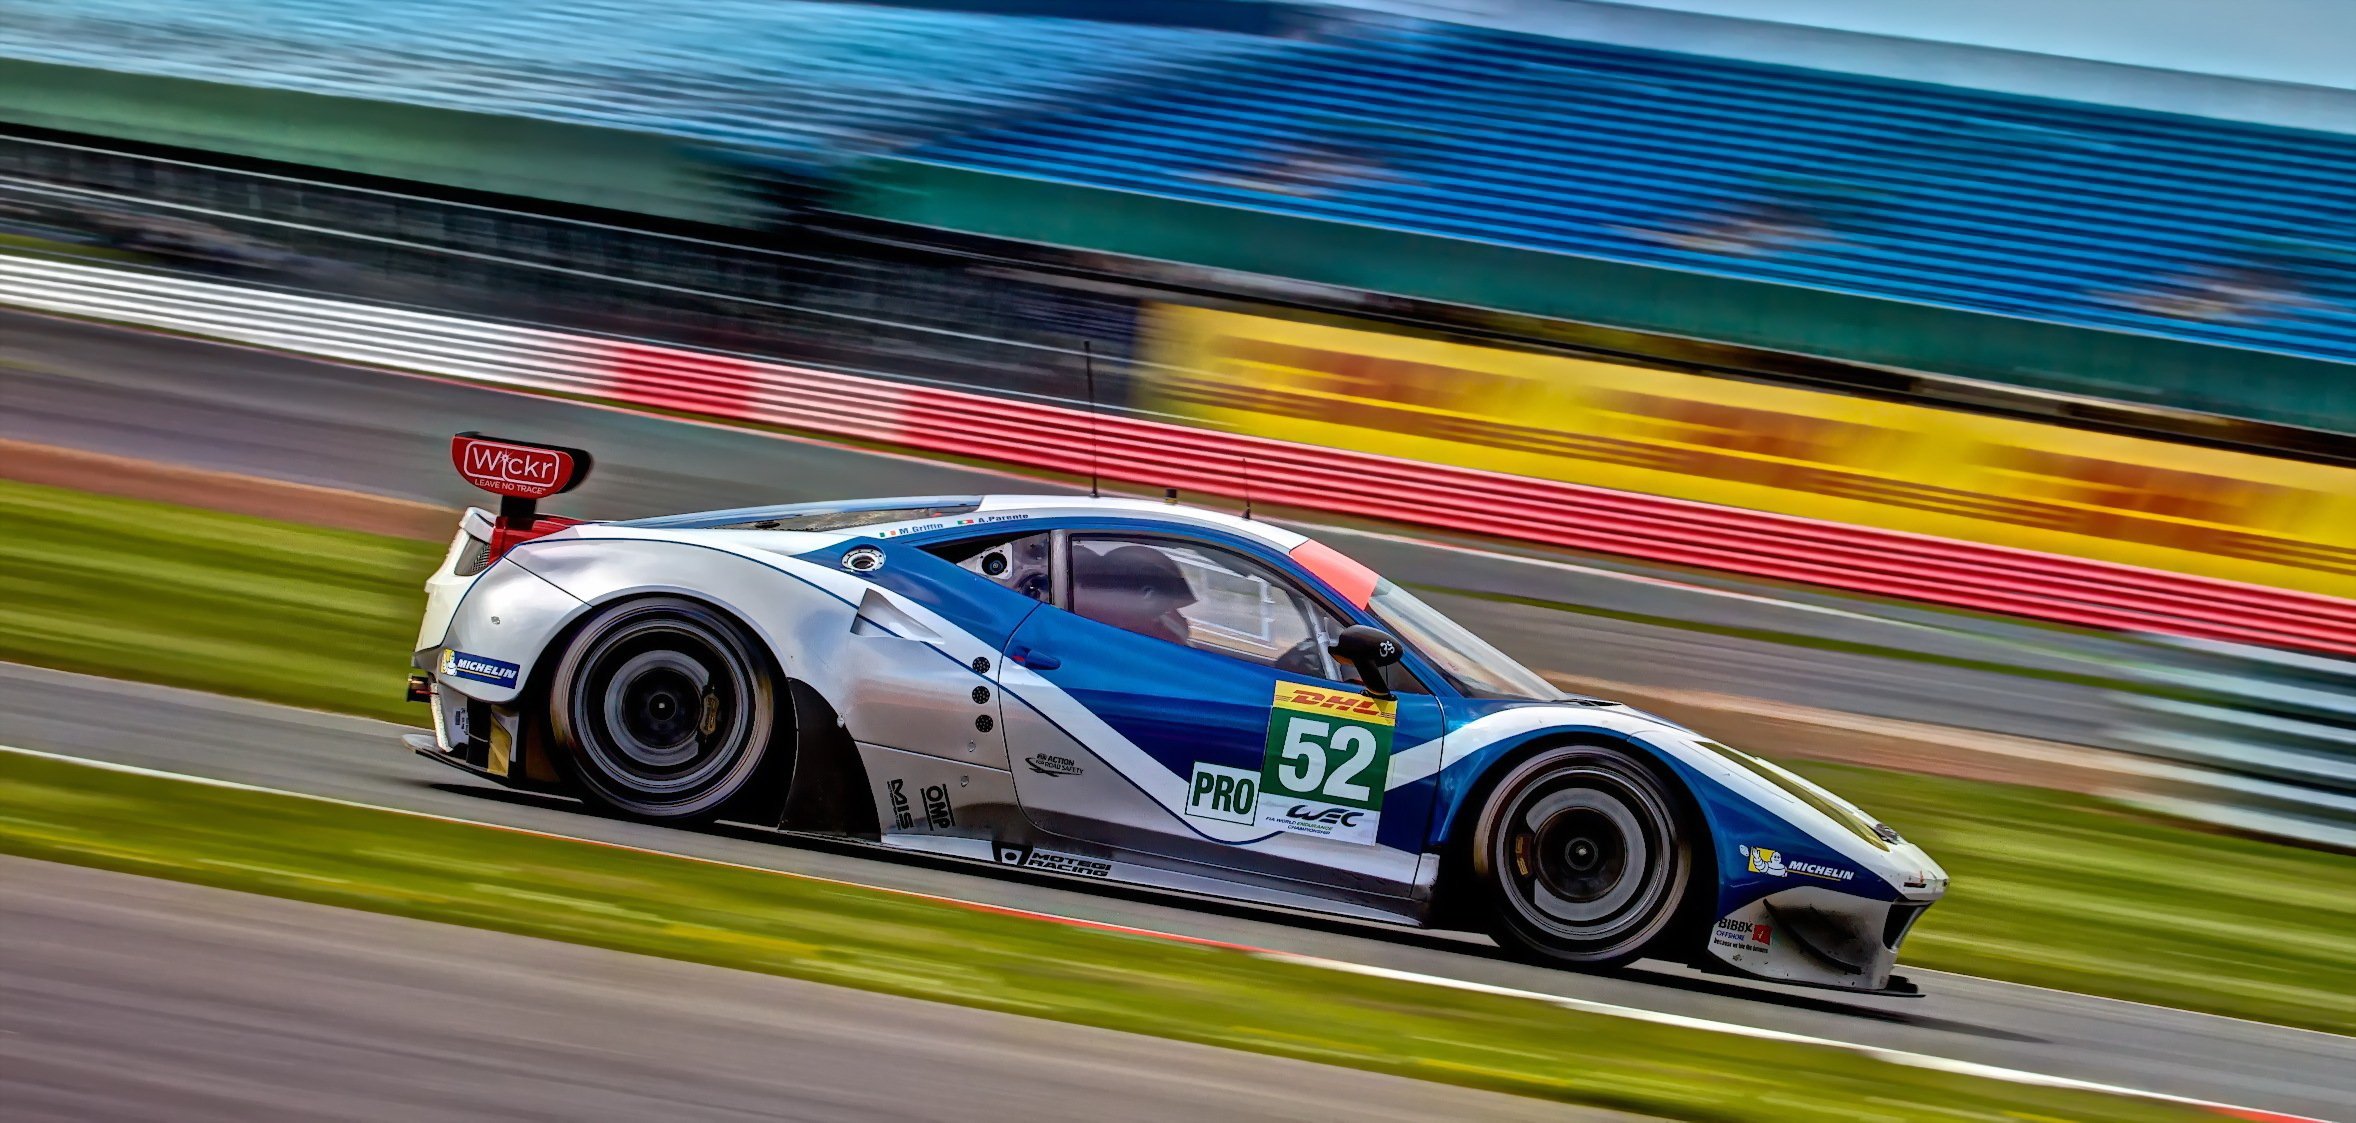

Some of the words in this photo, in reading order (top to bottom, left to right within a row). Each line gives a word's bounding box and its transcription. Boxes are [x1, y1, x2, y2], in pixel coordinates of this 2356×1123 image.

[473, 446, 553, 479] Wickr
[474, 478, 500, 489] LEAVE
[501, 482, 515, 491] NO
[457, 658, 517, 679] MICHELIN
[1289, 689, 1380, 716] DHL
[1047, 755, 1075, 767] ACTION
[1278, 716, 1377, 802] 52
[1191, 771, 1255, 815] PRO
[925, 785, 951, 829] OMP
[1286, 804, 1364, 827] WEC
[1276, 818, 1296, 826] WORLD
[1028, 860, 1109, 877] RACING
[1031, 852, 1112, 871] MOTEGI
[1788, 860, 1855, 881] MICHELIN
